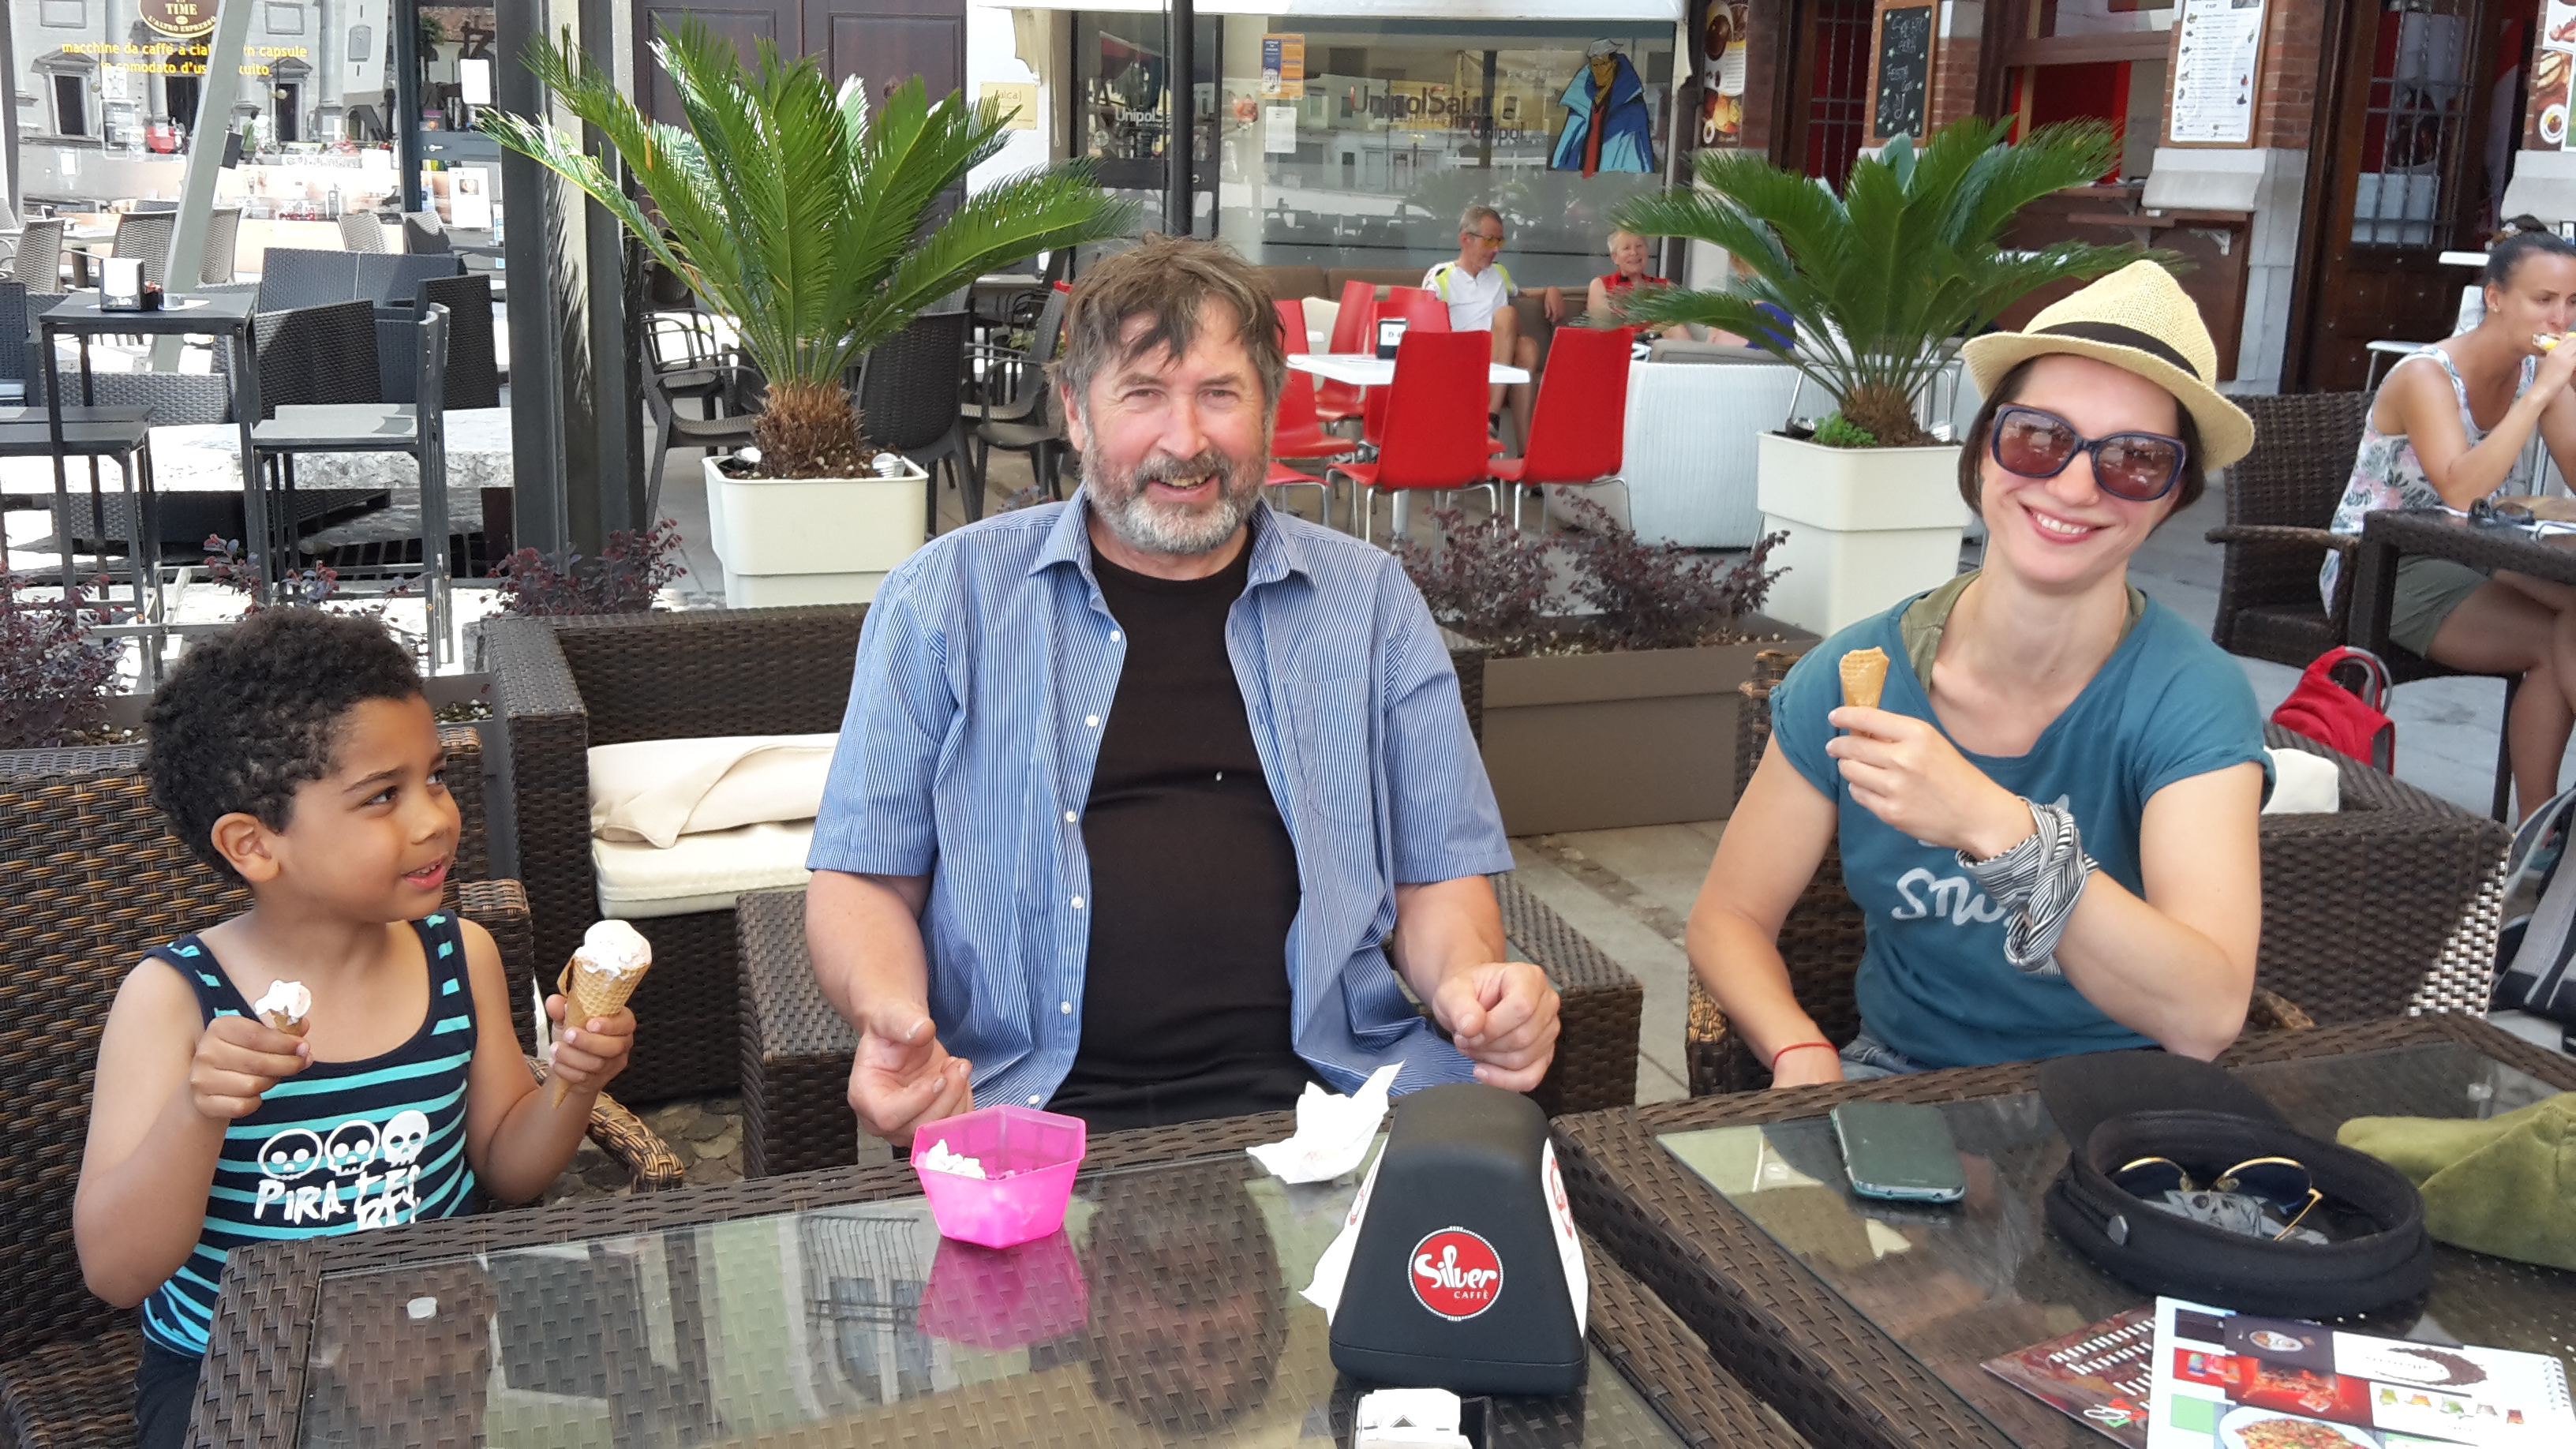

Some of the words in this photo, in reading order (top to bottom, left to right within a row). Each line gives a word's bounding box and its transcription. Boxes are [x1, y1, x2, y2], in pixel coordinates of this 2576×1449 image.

[165, 3, 197, 15] TIME
[148, 16, 179, 32] L'ALTRO
[62, 42, 119, 54] macchine
[123, 42, 139, 54] da
[178, 46, 186, 55] a
[189, 43, 211, 56] cial
[259, 45, 308, 59] capsule
[115, 62, 177, 74] comodato
[180, 62, 207, 74] d'us
[1414, 1245, 1498, 1289] Silver
[1453, 1290, 1488, 1300] CAFFÈ
